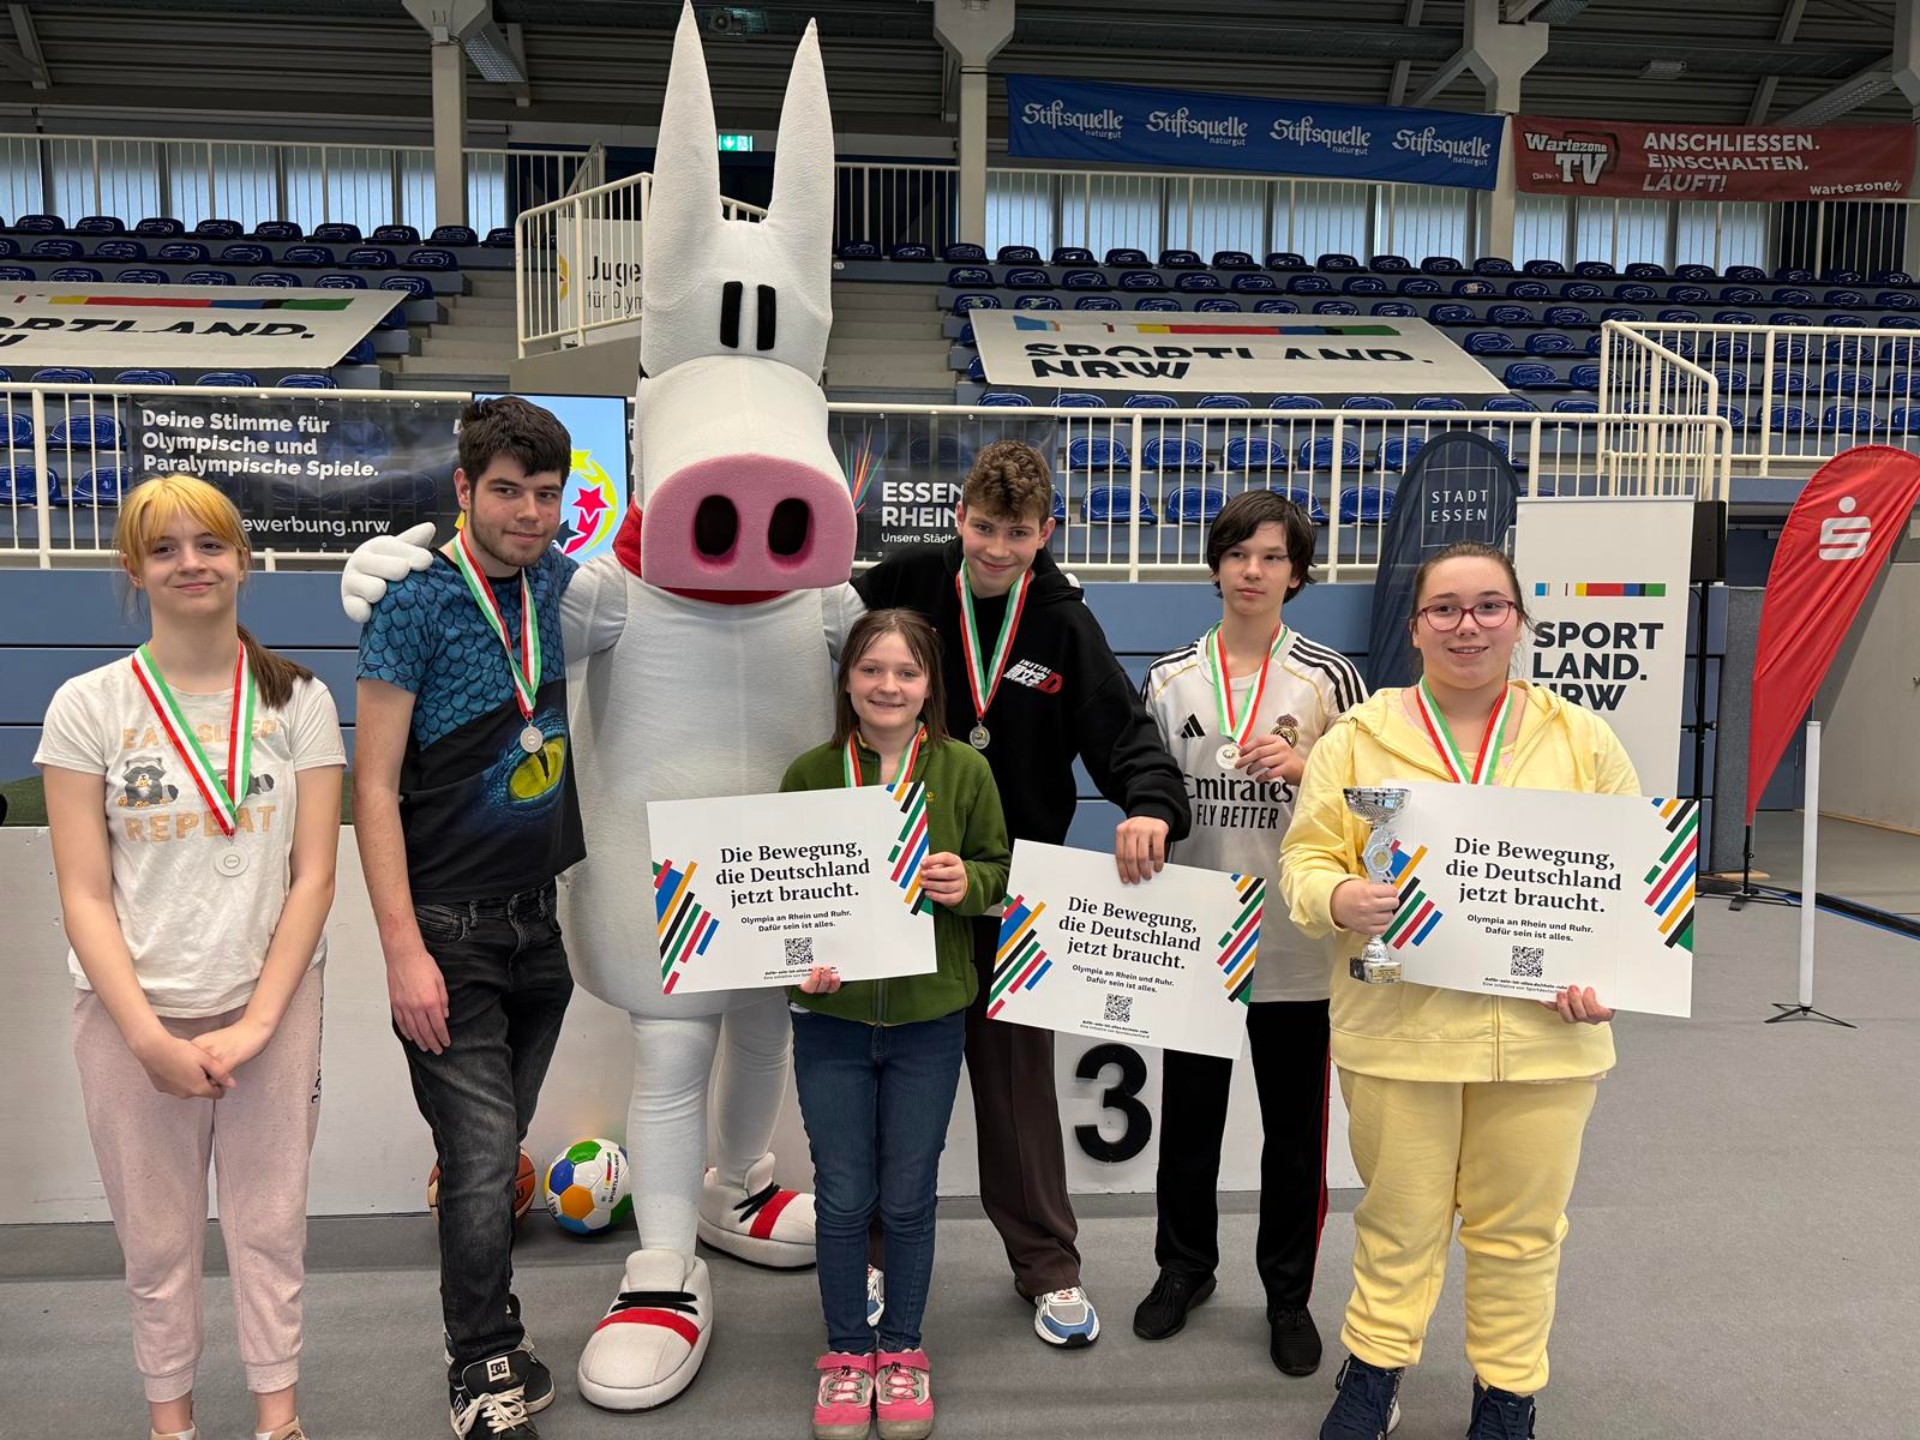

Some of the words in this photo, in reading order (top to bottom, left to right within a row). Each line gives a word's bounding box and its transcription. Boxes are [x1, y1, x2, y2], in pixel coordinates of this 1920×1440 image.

[1022, 99, 1124, 132] Stiftsquelle
[1146, 106, 1249, 139] Stiftsquelle
[1085, 129, 1123, 141] naturgut
[1209, 136, 1247, 147] naturgut
[1270, 115, 1372, 148] Stiftsquelle
[1392, 126, 1492, 158] Stiftsquelle
[1524, 132, 1608, 153] Wartezone
[1643, 132, 1820, 151] ANSCHLIESSEN.
[1332, 145, 1369, 157] naturgut
[1452, 155, 1489, 167] naturgut
[1648, 153, 1809, 171] EINSCHALTEN.
[1555, 153, 1609, 185] TV
[1642, 168, 1728, 192] LÄUFT!
[1031, 359, 1190, 379] NRW
[142, 409, 205, 428] Deine
[209, 413, 293, 433] Stimme
[297, 415, 330, 434] für
[142, 432, 270, 455] Olympische
[275, 439, 318, 455] und
[144, 454, 301, 478] Paralympische
[306, 460, 379, 481] Spiele.
[882, 481, 964, 503] ESSEN
[1431, 489, 1489, 504] STADT
[1430, 508, 1488, 523] ESSEN
[881, 533, 920, 543] Unsere
[1533, 621, 1664, 650] SPORT
[1532, 652, 1647, 681] LAND.
[1196, 803, 1218, 826] FLY
[1220, 806, 1279, 829] BETTER
[720, 846, 752, 864] Die
[757, 840, 864, 863] Bewegung,
[1454, 837, 1490, 856] Die
[1497, 840, 1616, 871] Bewegung,
[715, 869, 745, 885] die
[750, 859, 871, 884] Deutschland
[1445, 859, 1479, 878] die
[1484, 862, 1622, 891] Deutschland
[730, 887, 774, 909] jetzt
[779, 882, 860, 904] braucht.
[1459, 882, 1508, 904] jetzt
[1514, 887, 1606, 913] braucht.
[741, 914, 775, 925] Olympia
[776, 914, 787, 922] an
[788, 912, 811, 921] Rhein
[813, 911, 829, 920] und
[830, 909, 852, 918] Ruhr.
[758, 923, 781, 933] Dafür
[783, 922, 801, 931] sein
[801, 921, 813, 930] ist
[814, 919, 836, 929] alles.
[1067, 896, 1097, 915] Die
[1103, 902, 1197, 933] Bewegung,
[1467, 914, 1505, 927] Olympia
[1507, 918, 1519, 927] an
[1521, 918, 1548, 930] Rhein
[1549, 921, 1567, 931] und
[1569, 922, 1594, 934] Ruhr.
[1058, 916, 1086, 932] die
[1091, 920, 1202, 952] Deutschland
[1485, 926, 1511, 937] Dafür
[1513, 929, 1533, 938] sein
[1534, 930, 1547, 940] ist
[1548, 931, 1574, 942] alles.
[1067, 937, 1108, 957] jetzt
[1113, 944, 1186, 970] braucht.
[1072, 964, 1103, 976] Olympia
[1115, 970, 1137, 980] Rhein
[1139, 974, 1154, 983] und
[1155, 976, 1175, 987] Ruhr.
[1086, 976, 1107, 985] Dafür
[1109, 979, 1125, 988] sein
[1126, 981, 1136, 990] ist
[1137, 983, 1158, 994] alles.
[1074, 1043, 1152, 1163] 3
